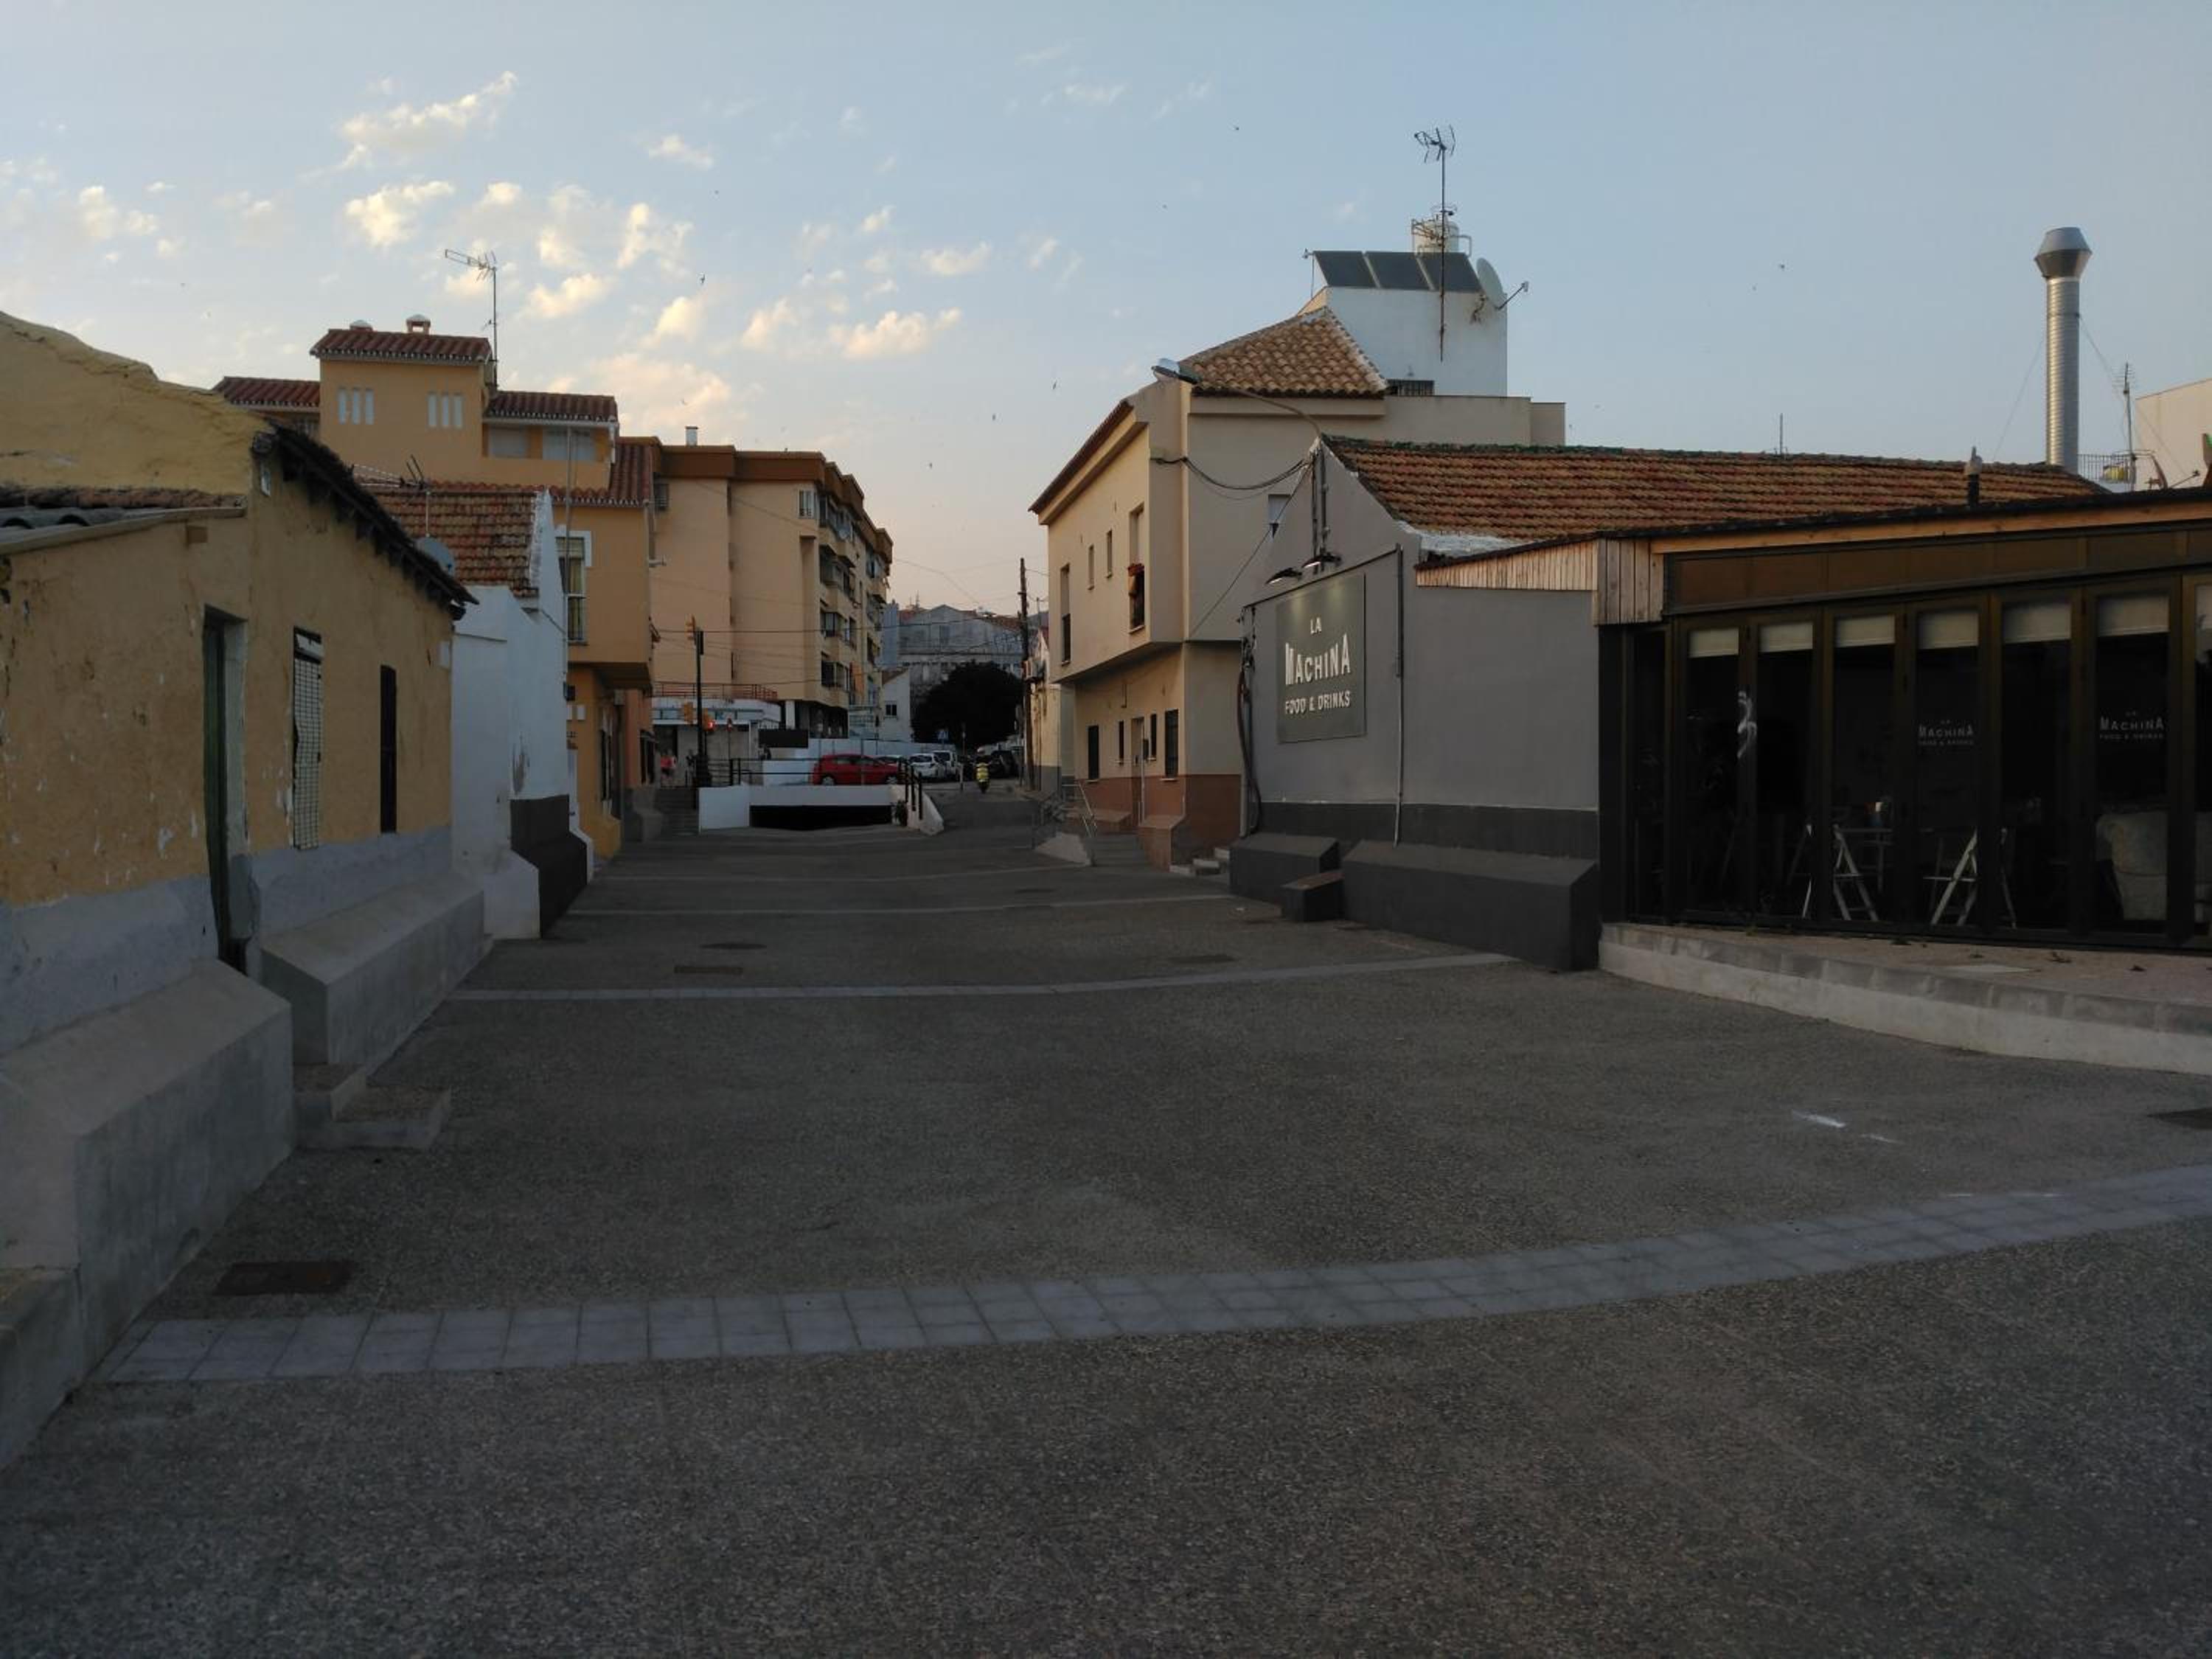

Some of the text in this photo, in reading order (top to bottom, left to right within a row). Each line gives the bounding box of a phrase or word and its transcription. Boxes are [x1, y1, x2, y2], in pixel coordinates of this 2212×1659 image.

[1310, 617, 1322, 634] LA
[1285, 633, 1351, 686] MACHINA
[1285, 690, 1350, 714] FOOD & DRINKS
[2100, 715, 2165, 731] MACHINA
